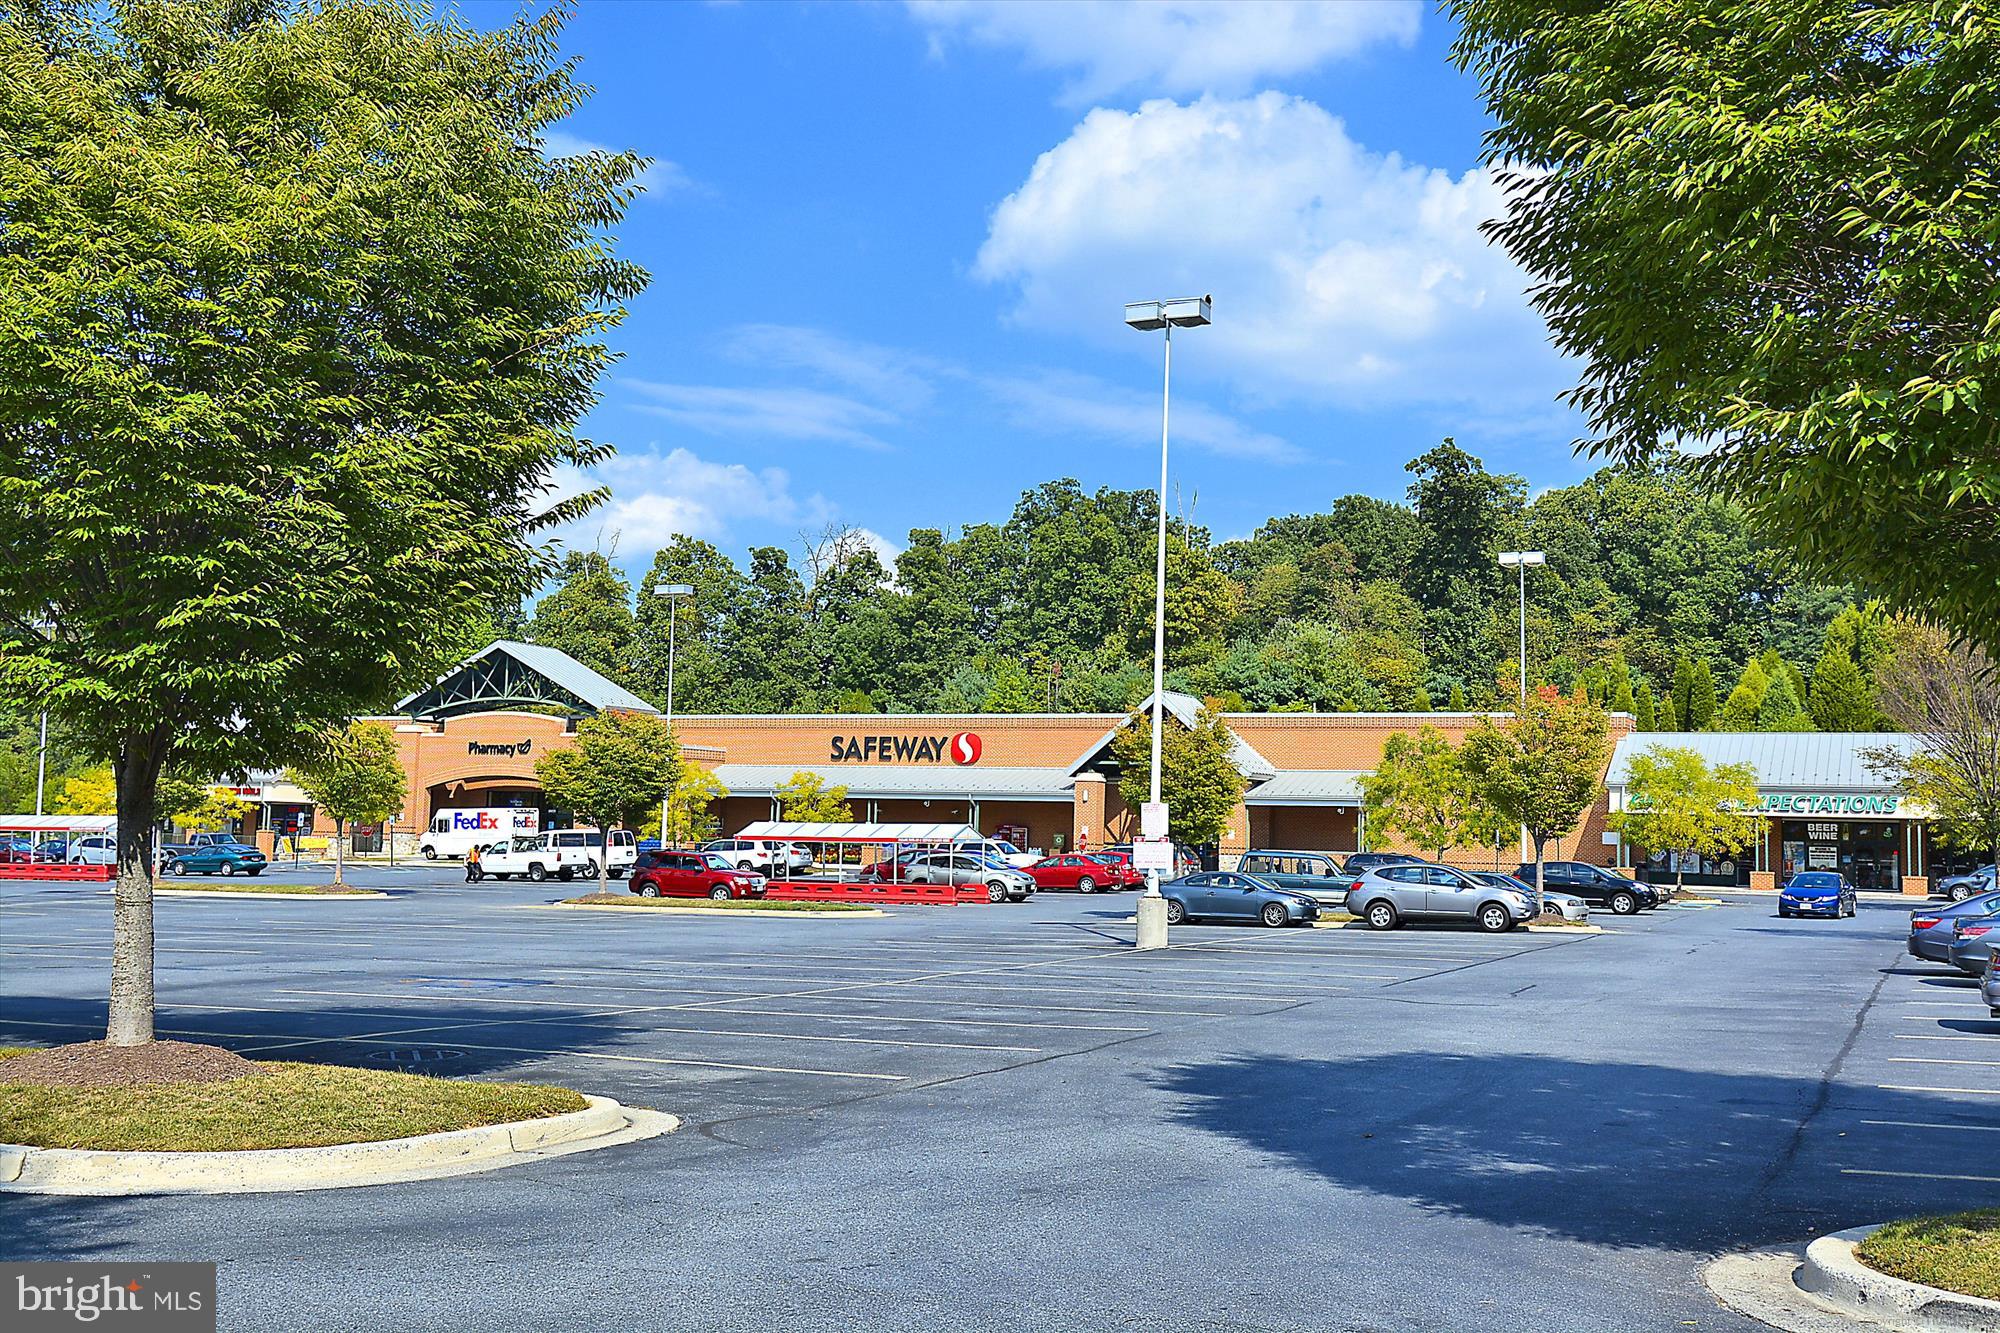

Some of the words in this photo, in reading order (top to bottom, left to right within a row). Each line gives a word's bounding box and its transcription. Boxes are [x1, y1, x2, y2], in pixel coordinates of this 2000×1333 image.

[468, 741, 516, 758] Pharmacy
[831, 736, 948, 762] SAFEWAY
[454, 812, 498, 830] FedEx
[513, 817, 537, 828] FedEx
[1807, 824, 1838, 832] BEER
[1808, 832, 1838, 840] WINE
